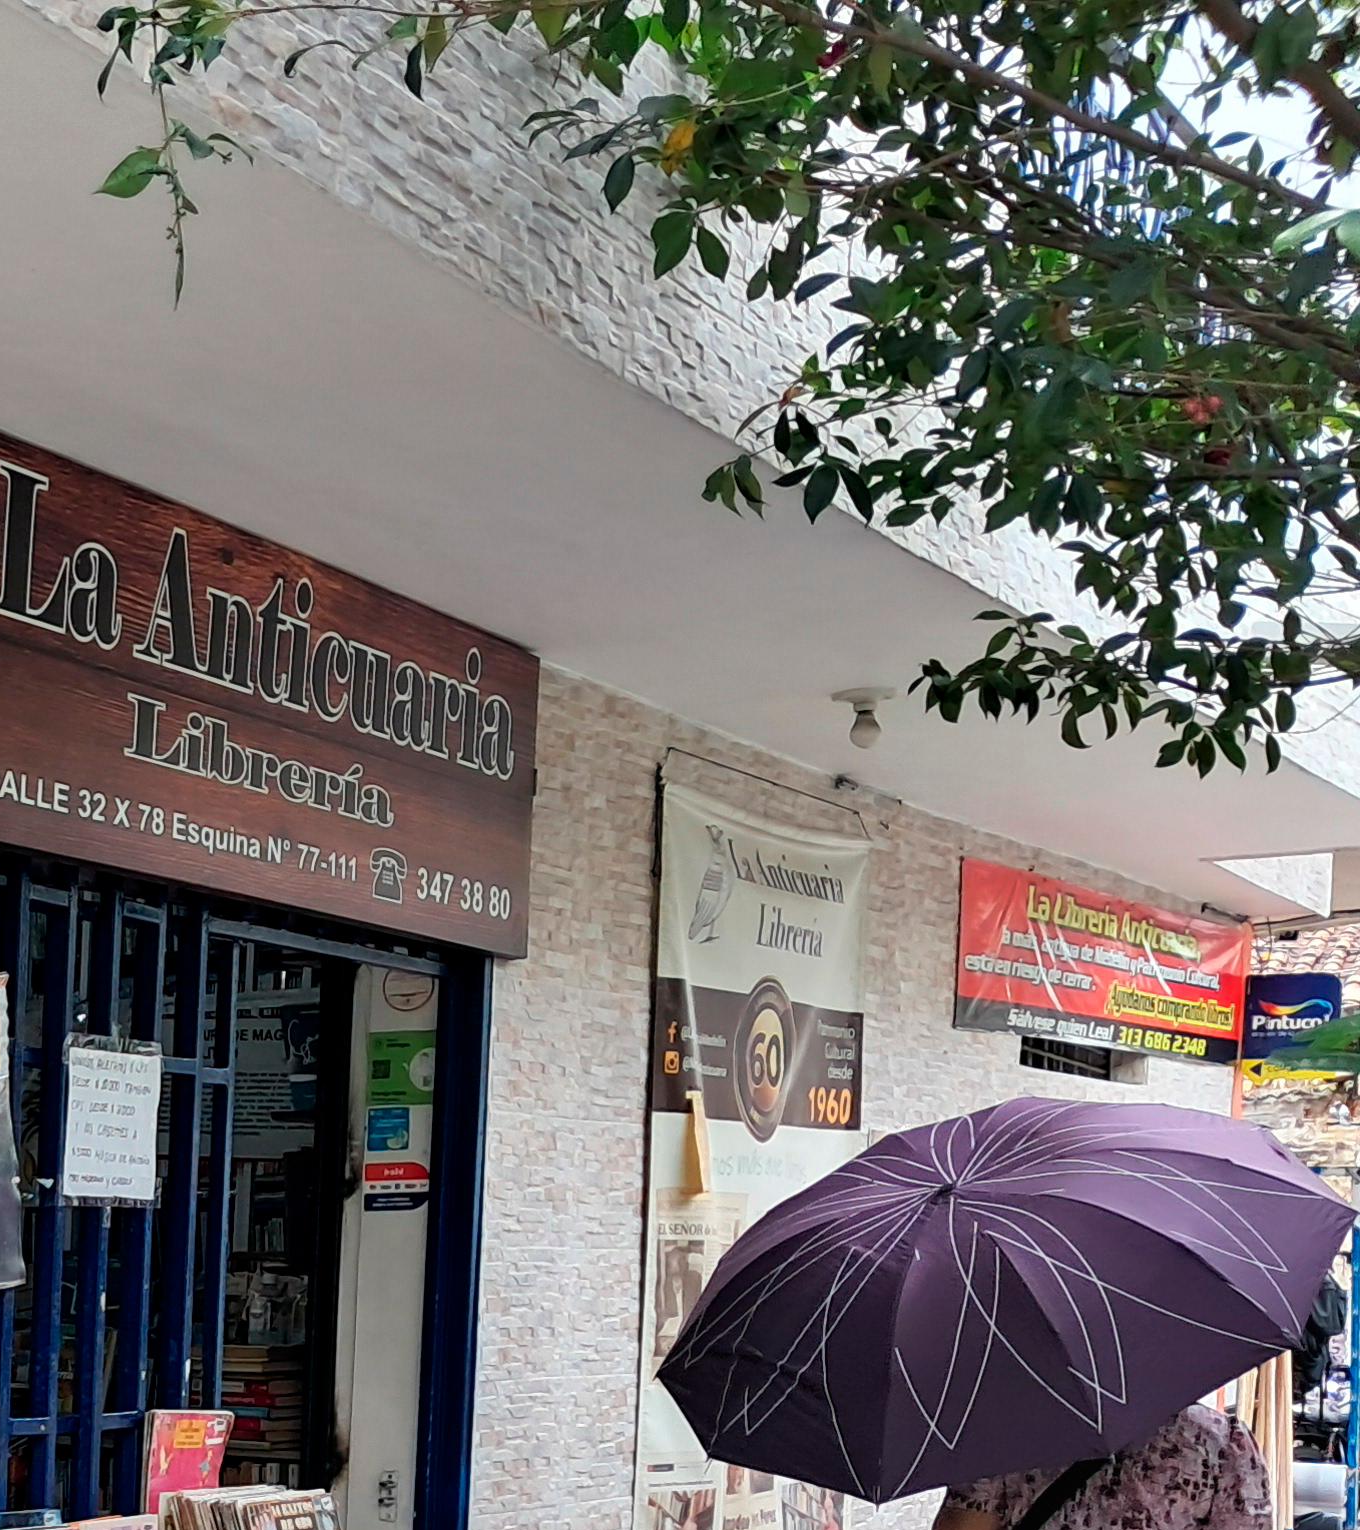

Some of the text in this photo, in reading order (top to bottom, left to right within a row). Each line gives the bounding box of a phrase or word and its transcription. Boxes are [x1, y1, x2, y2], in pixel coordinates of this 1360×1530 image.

[133, 527, 516, 780] Anticuaria
[123, 692, 394, 827] Librería
[78, 790, 106, 822] 32
[112, 797, 131, 828] X
[138, 803, 165, 836] 78
[172, 814, 261, 860] Esquina
[297, 843, 358, 882] 77-111
[727, 838, 844, 904] La Anticuaria
[416, 867, 511, 920] 347 38 80
[1027, 884, 1050, 920] La
[252, 1029, 286, 1041] MAG
[1057, 1020, 1088, 1039] quien
[1117, 1026, 1206, 1057] 313 686 2348
[1251, 1014, 1323, 1031] Pintuco
[750, 1032, 782, 1088] 60
[808, 1086, 852, 1125] 1960
[669, 1219, 703, 1236] SEÑOR
